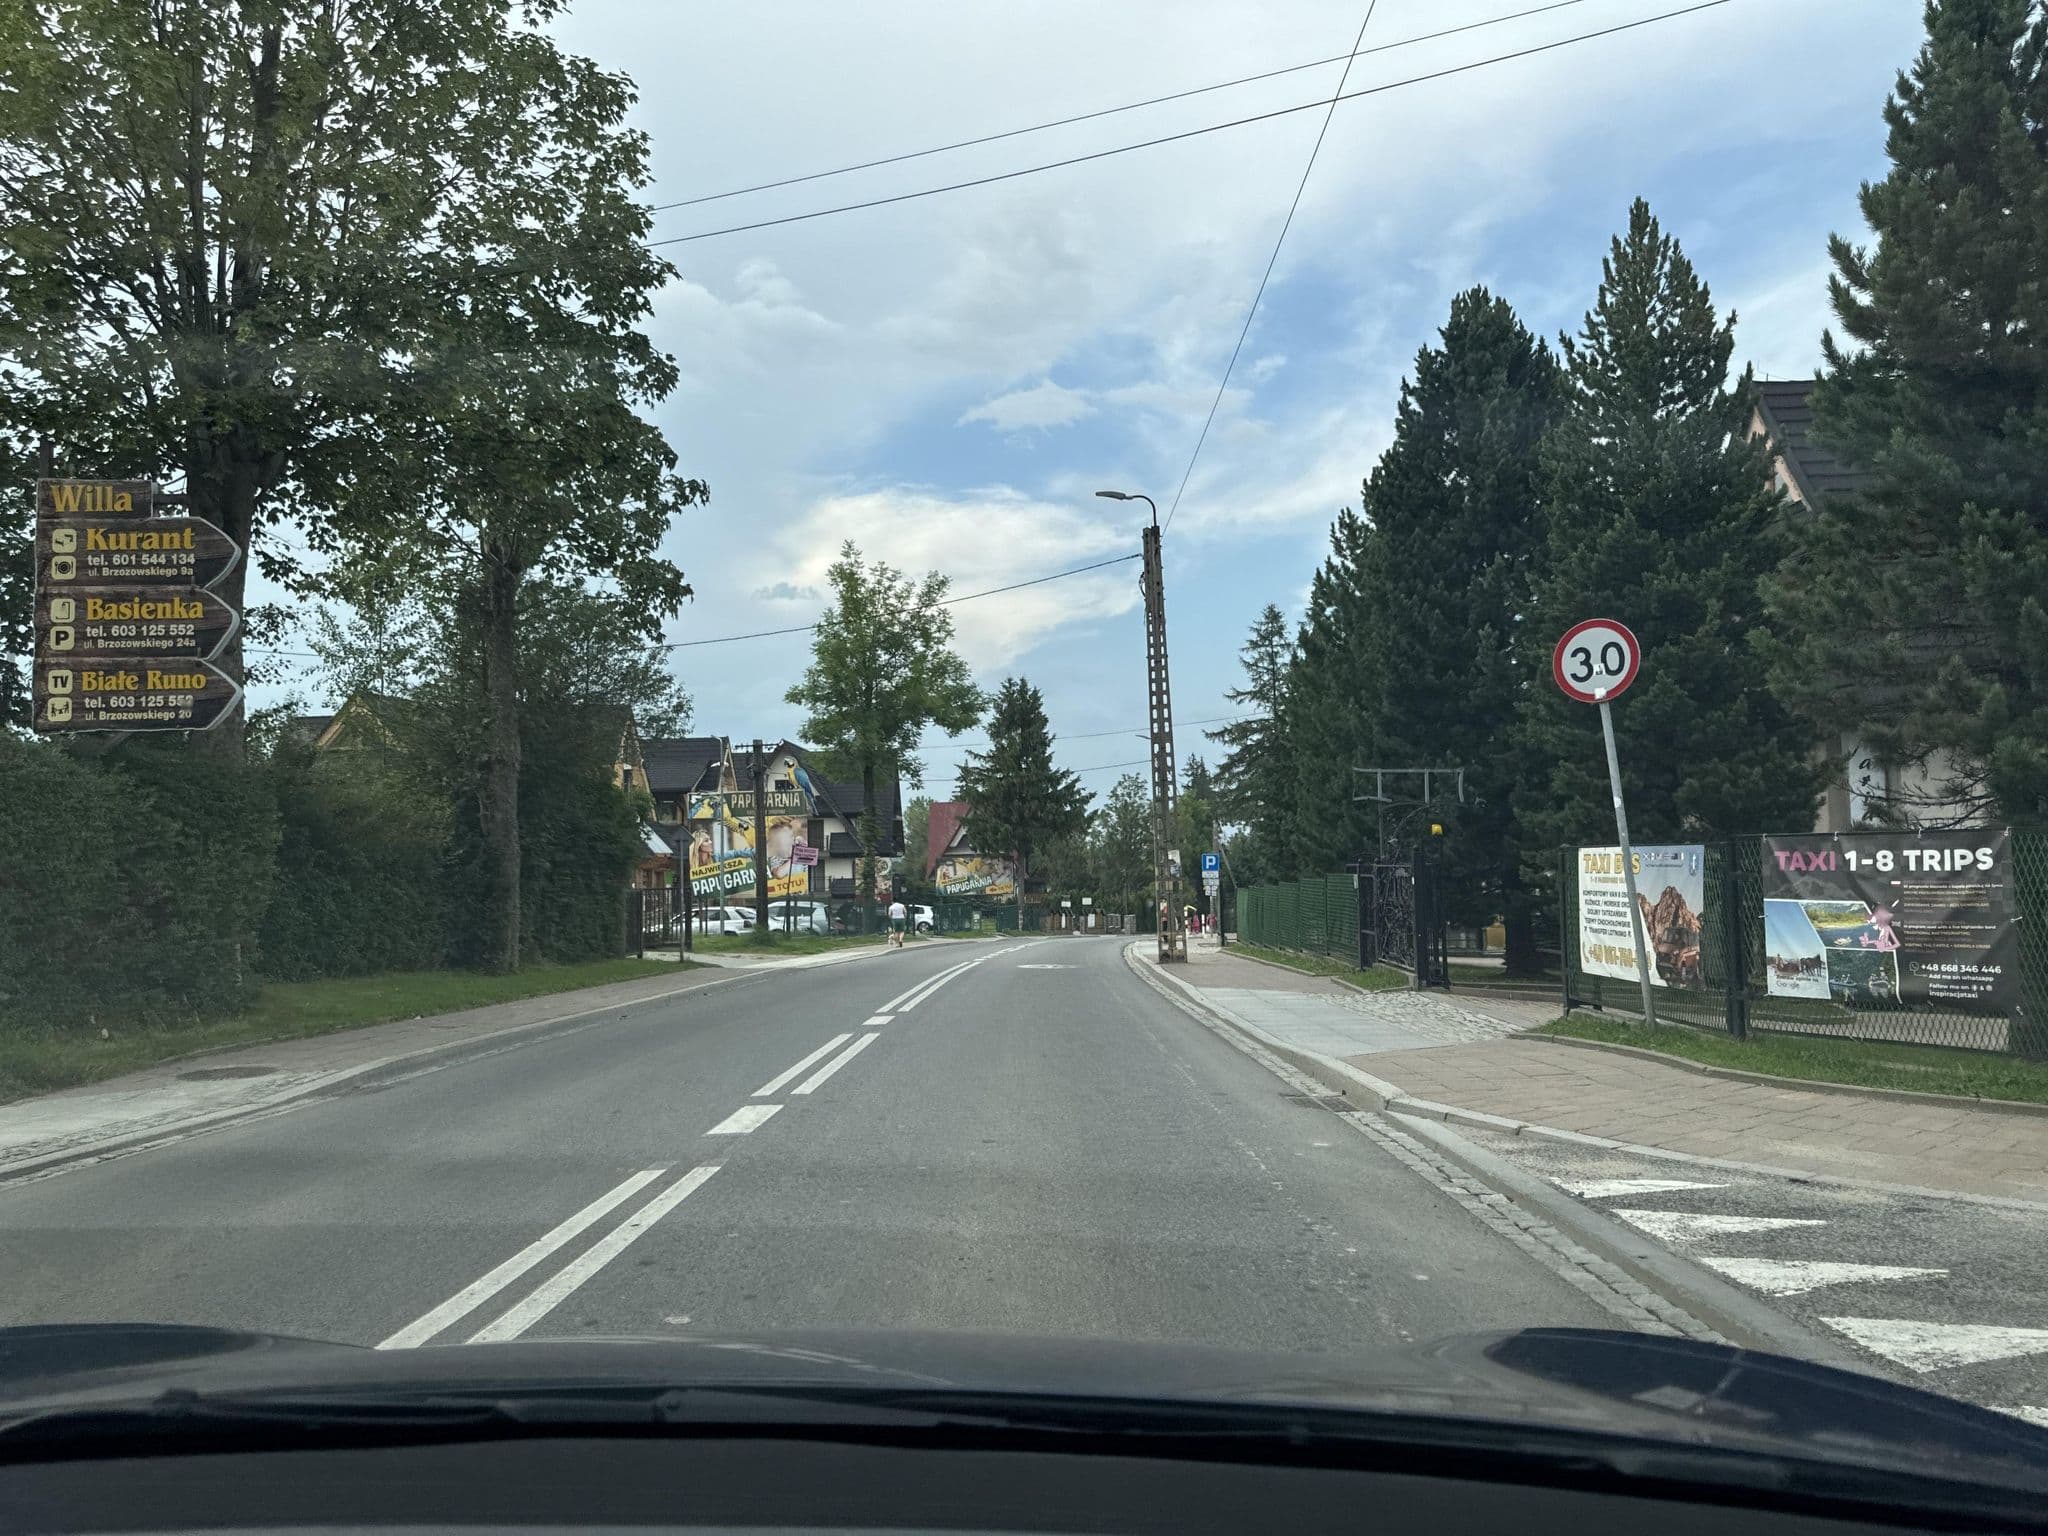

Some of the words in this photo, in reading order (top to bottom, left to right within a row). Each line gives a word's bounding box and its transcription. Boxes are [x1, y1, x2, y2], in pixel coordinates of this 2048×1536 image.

[51, 485, 133, 512] Willa
[86, 527, 196, 550] Kurant
[88, 554, 108, 566] tel.
[112, 554, 136, 565] 601
[142, 554, 166, 565] 544
[172, 554, 195, 565] 134
[88, 568, 100, 576] ul.
[102, 567, 177, 578] Brzozowskiego
[181, 567, 193, 575] 9a
[86, 597, 204, 620] Basienka
[86, 626, 107, 637] tel.
[111, 625, 136, 636] 603
[141, 625, 165, 636] 125
[170, 624, 194, 635] 552
[84, 640, 95, 649] ul.
[98, 639, 173, 650] Brzozowskiego
[176, 638, 196, 647] 24a
[1570, 642, 1625, 682] 30
[52, 676, 69, 688] TV
[82, 670, 139, 690] Białe
[147, 670, 206, 690] Runo
[85, 698, 106, 709] tel.
[110, 696, 134, 707] 603
[140, 696, 164, 707] 125
[85, 712, 96, 721] ul.
[99, 711, 175, 722] Brzozowskiego
[731, 793, 800, 808] PAPARNIA
[1206, 856, 1216, 869] P
[1584, 853, 1610, 874] TAXI
[1615, 853, 1640, 875] BS
[1775, 850, 1836, 871] TAXI
[1844, 849, 1894, 871] 1-8
[1903, 847, 1993, 871] TRIPS
[1921, 963, 1939, 972] +48
[1941, 964, 1958, 972] 668
[1960, 965, 1978, 973] 346
[1981, 965, 2001, 974] 446
[1776, 981, 1800, 989] Gogle
